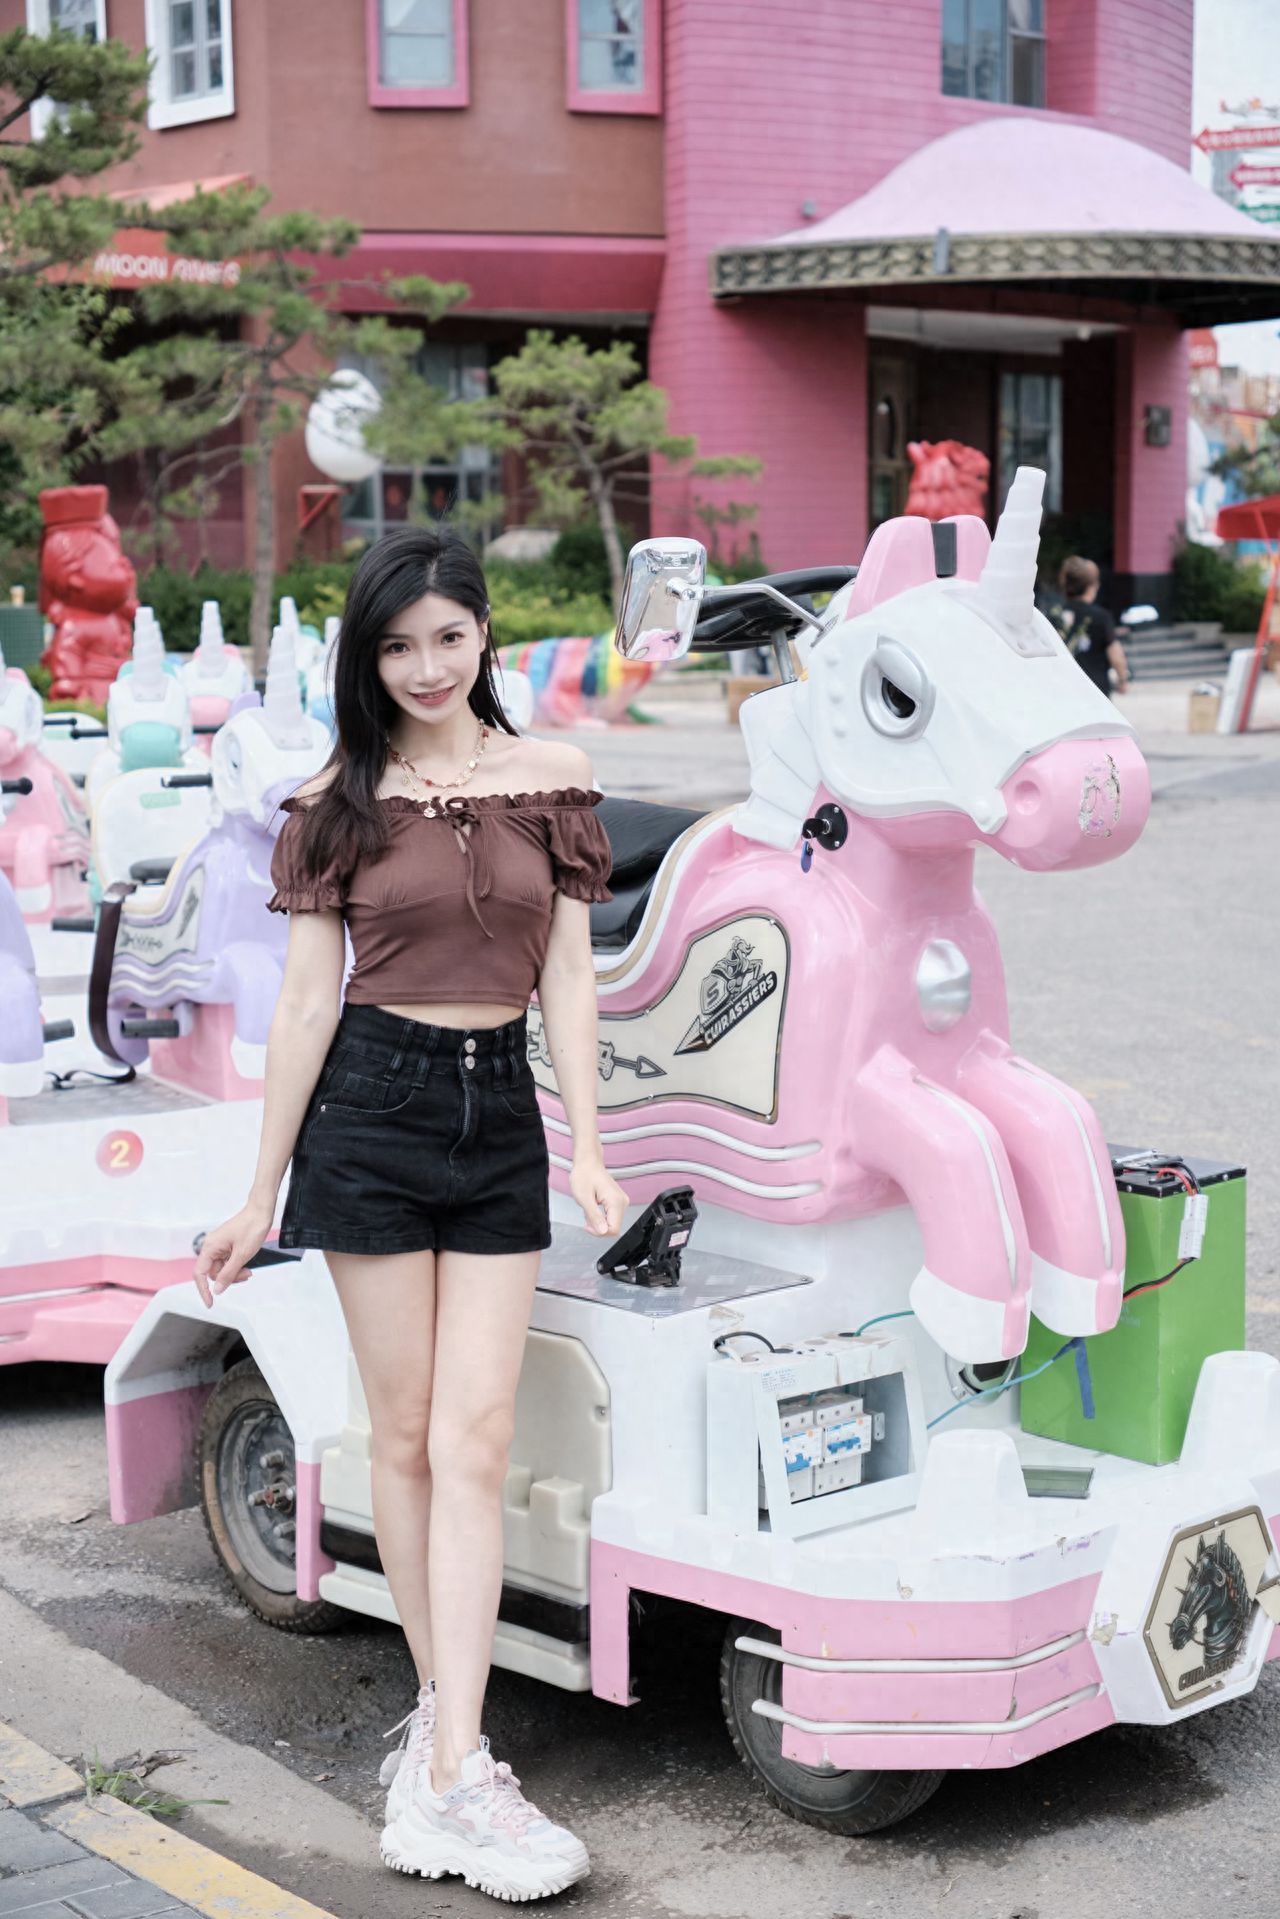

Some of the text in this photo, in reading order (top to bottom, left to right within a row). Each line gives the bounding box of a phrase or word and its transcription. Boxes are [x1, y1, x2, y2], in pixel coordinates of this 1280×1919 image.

[93, 252, 168, 281] MOON
[703, 973, 775, 1046] CUIRASSIERS
[110, 1139, 130, 1168] 2
